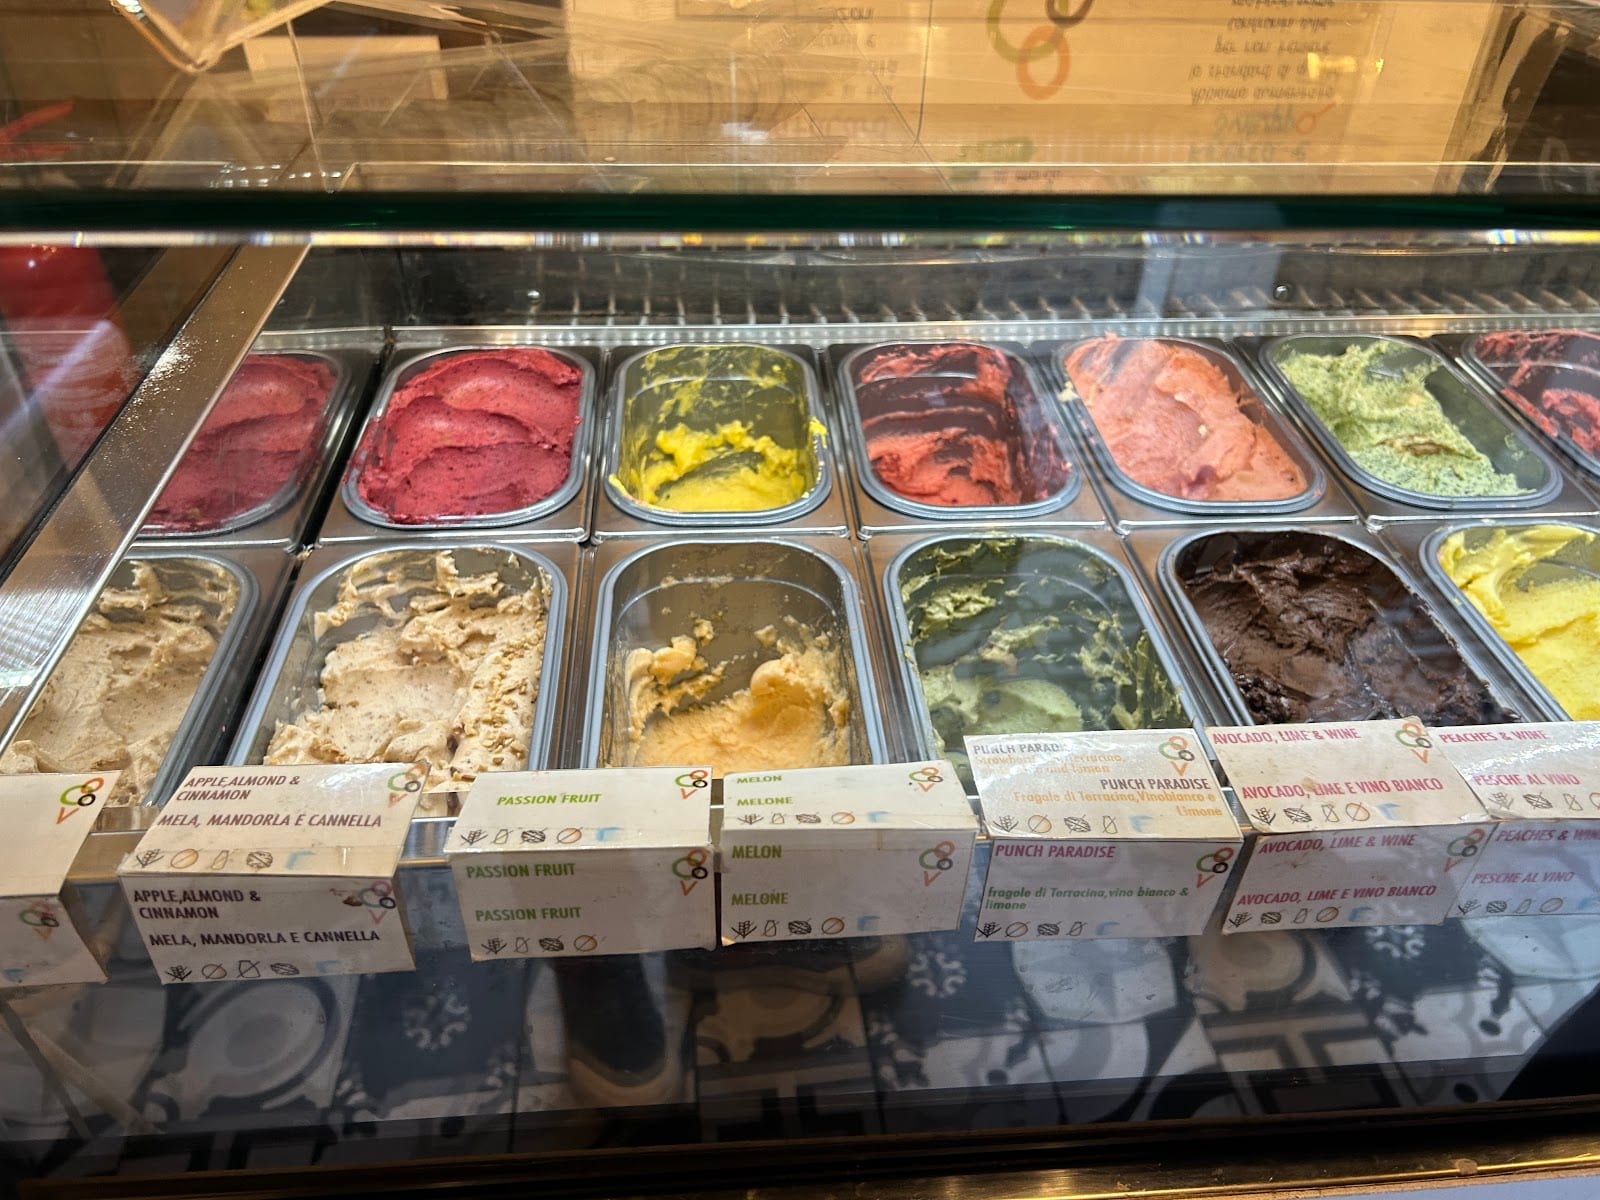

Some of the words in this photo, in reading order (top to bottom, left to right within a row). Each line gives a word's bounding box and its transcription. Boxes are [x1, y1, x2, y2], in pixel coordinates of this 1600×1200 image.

[1213, 731, 1277, 745] AVOCADO,
[1281, 730, 1309, 742] LIME
[1312, 730, 1321, 740] &
[1324, 729, 1361, 740] WINE
[1439, 731, 1498, 744] PEACHES
[1501, 732, 1511, 741] &
[1512, 730, 1549, 740] WINE
[290, 775, 300, 785] &
[736, 774, 782, 785] MELON
[1100, 779, 1144, 790] PUNCH
[1147, 778, 1212, 790] PARADISE
[1474, 775, 1525, 786] PESCHE
[1525, 774, 1542, 785] AL
[1547, 774, 1581, 785] VINO
[176, 789, 251, 801] CINNAMON
[1242, 784, 1310, 800] AVOCADO,
[1312, 783, 1343, 796] LIME
[1347, 782, 1355, 794] E
[1358, 780, 1391, 793] VINO
[1395, 778, 1443, 791] BIANCO
[497, 794, 557, 806] PASSION
[560, 793, 602, 804] FRUIT
[737, 796, 794, 807] MELONE
[1176, 806, 1223, 817] Limone
[158, 815, 201, 828] MELA,
[207, 814, 289, 827] MANDORLA
[295, 814, 303, 826] E
[308, 814, 382, 827] CANNELLA
[1496, 830, 1553, 842] PEACHES
[1558, 831, 1568, 841] &
[1259, 838, 1326, 855] AVOCADO,
[1329, 836, 1365, 849] LIME
[1368, 836, 1378, 847] &
[1381, 834, 1417, 847] WINE
[731, 845, 782, 860] MELON
[995, 845, 1043, 857] PUNCH
[1048, 845, 1116, 858] PARADISE
[466, 864, 530, 878] PASSION
[534, 863, 576, 876] FRUIT
[1472, 873, 1522, 884] PESCHE
[1522, 872, 1537, 883] AL
[1544, 872, 1576, 882] VINO
[133, 890, 244, 905] APPLE,ALMOND
[249, 890, 261, 902] &
[1035, 887, 1046, 898] di
[1137, 887, 1176, 897] bianco
[1179, 887, 1189, 896] &
[1237, 890, 1302, 906] AVOCADO,
[1306, 888, 1338, 901] LIME
[1341, 888, 1351, 899] E
[1353, 886, 1385, 898] VINO
[1388, 884, 1436, 897] BIANCO
[731, 892, 788, 907] MELONE
[985, 899, 1027, 910] limone
[139, 906, 219, 920] CINNAMON
[475, 907, 537, 921] PASSION
[541, 906, 582, 919] FRUIT
[150, 933, 196, 948] MELA,
[202, 932, 288, 946] MANDORLA
[292, 932, 301, 944] E
[304, 930, 380, 944] CANNELLA
